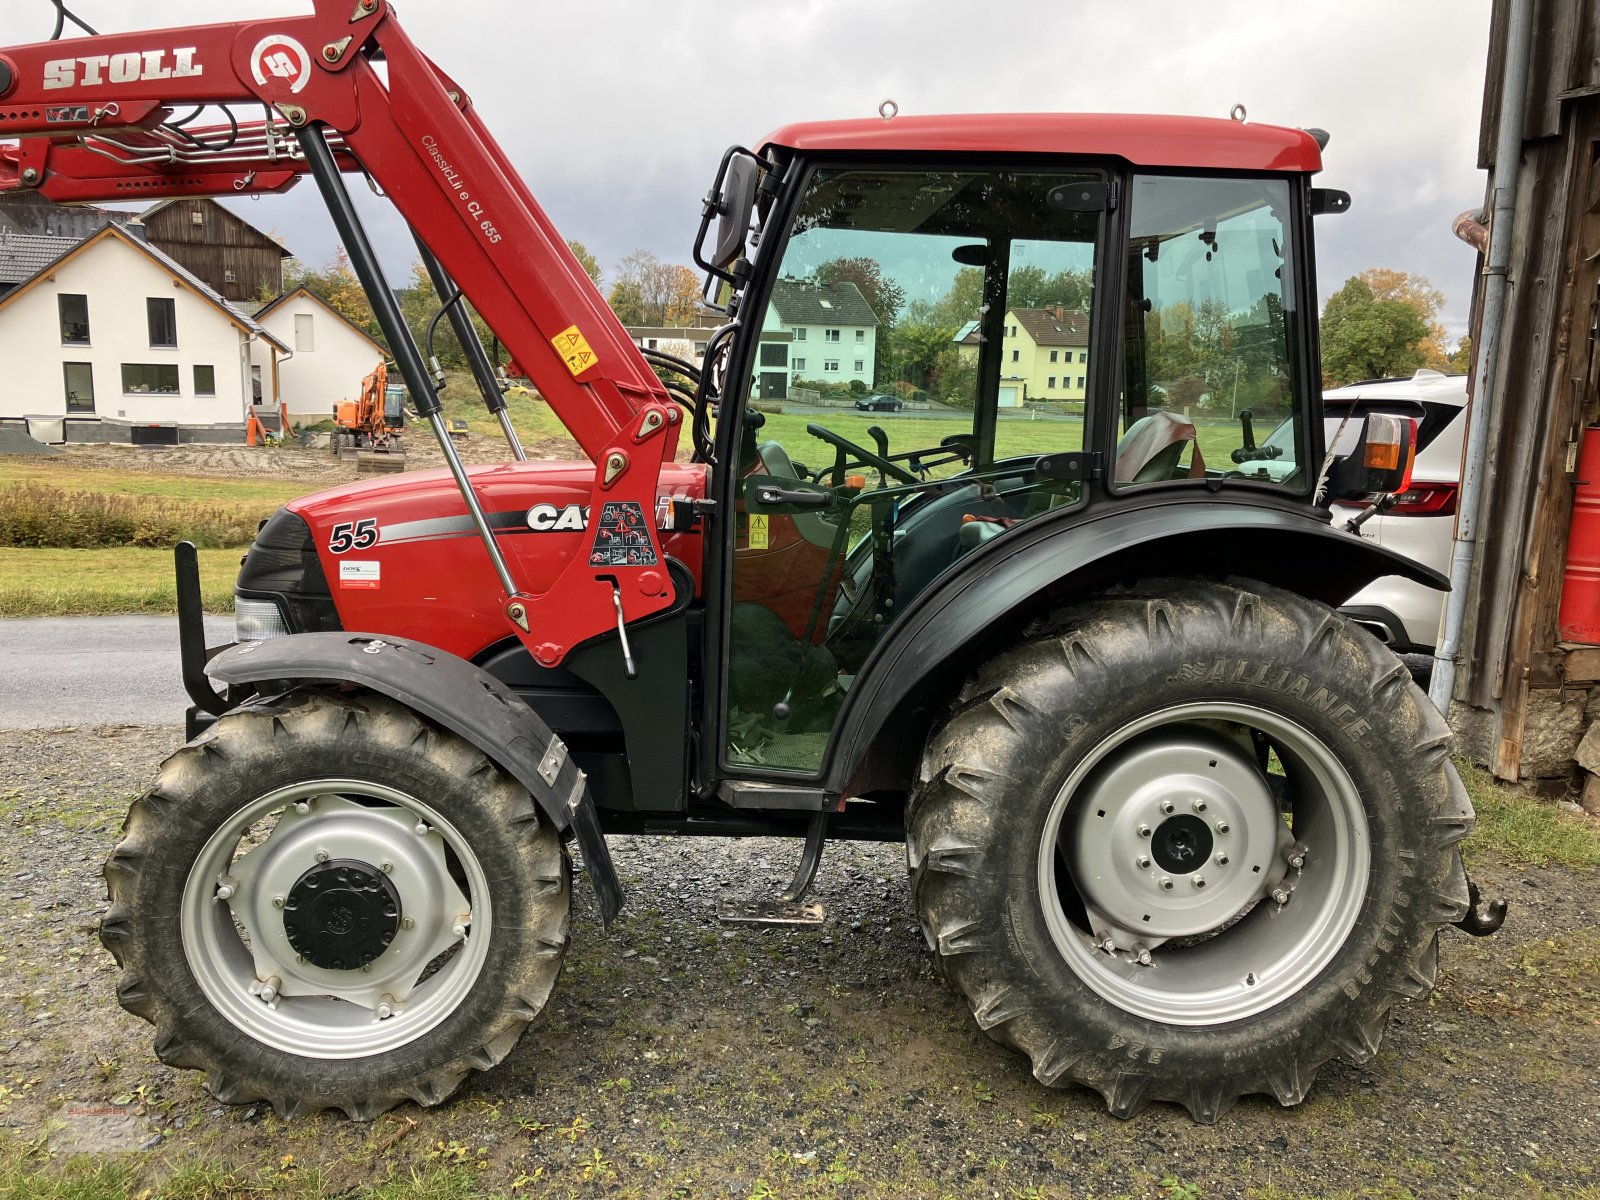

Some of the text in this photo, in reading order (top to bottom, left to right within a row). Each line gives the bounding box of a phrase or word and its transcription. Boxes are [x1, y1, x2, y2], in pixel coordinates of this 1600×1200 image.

[43, 47, 203, 90] STOLL
[467, 201, 484, 221] CL
[480, 220, 502, 244] 655
[328, 517, 378, 554] 55
[1206, 657, 1374, 743] ALLIANCE
